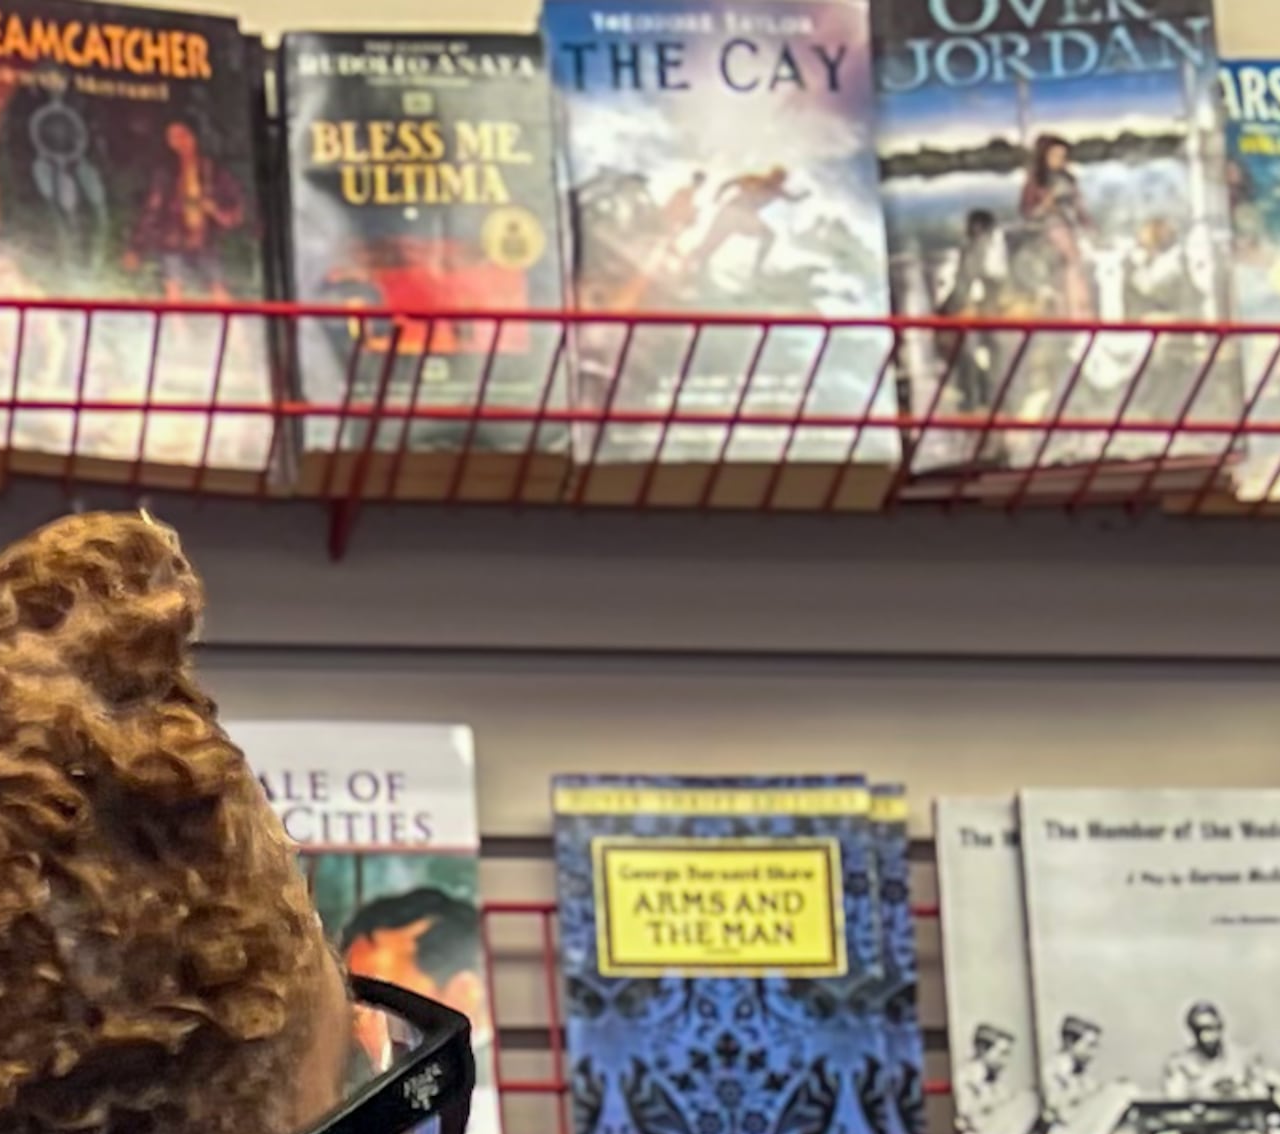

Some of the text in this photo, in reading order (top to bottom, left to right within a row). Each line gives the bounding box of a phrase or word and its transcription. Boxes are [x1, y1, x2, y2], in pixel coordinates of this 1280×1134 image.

[591, 11, 814, 35] THEODORE TAYLOR
[298, 53, 537, 79] RUDOLFO ANAYA
[562, 38, 848, 94] THE CAY
[878, 16, 1211, 91] JORDAN
[311, 121, 444, 162] BLESS
[340, 162, 511, 205] ULTIMA
[347, 769, 407, 802] OF
[284, 806, 435, 846] CITIES
[958, 826, 994, 847] The
[1044, 820, 1079, 841] The
[1173, 819, 1193, 841] of
[1201, 819, 1232, 840] the
[633, 889, 806, 917] ARMS AND
[647, 919, 796, 947] THE MAN
